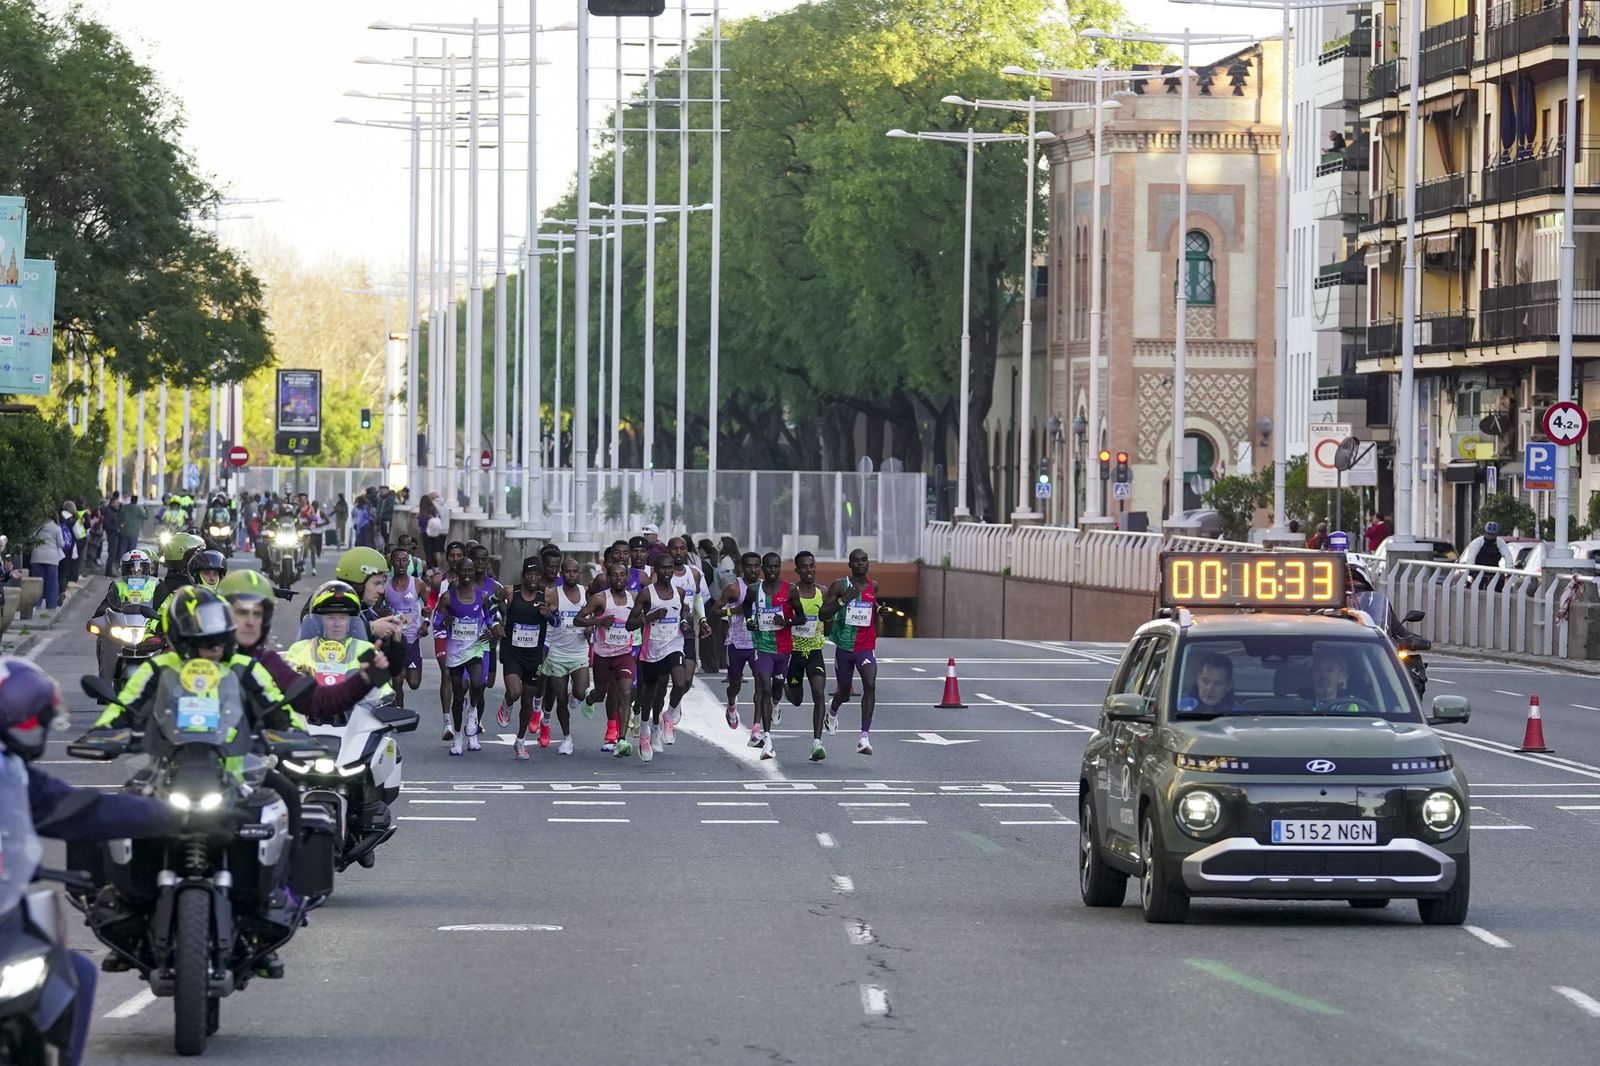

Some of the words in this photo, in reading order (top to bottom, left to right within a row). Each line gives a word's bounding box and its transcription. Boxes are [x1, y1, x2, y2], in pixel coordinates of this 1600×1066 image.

[1529, 447, 1548, 472] P
[1172, 560, 1333, 599] 00:16:33
[1285, 824, 1331, 840] 5152
[1338, 824, 1372, 840] NGN
